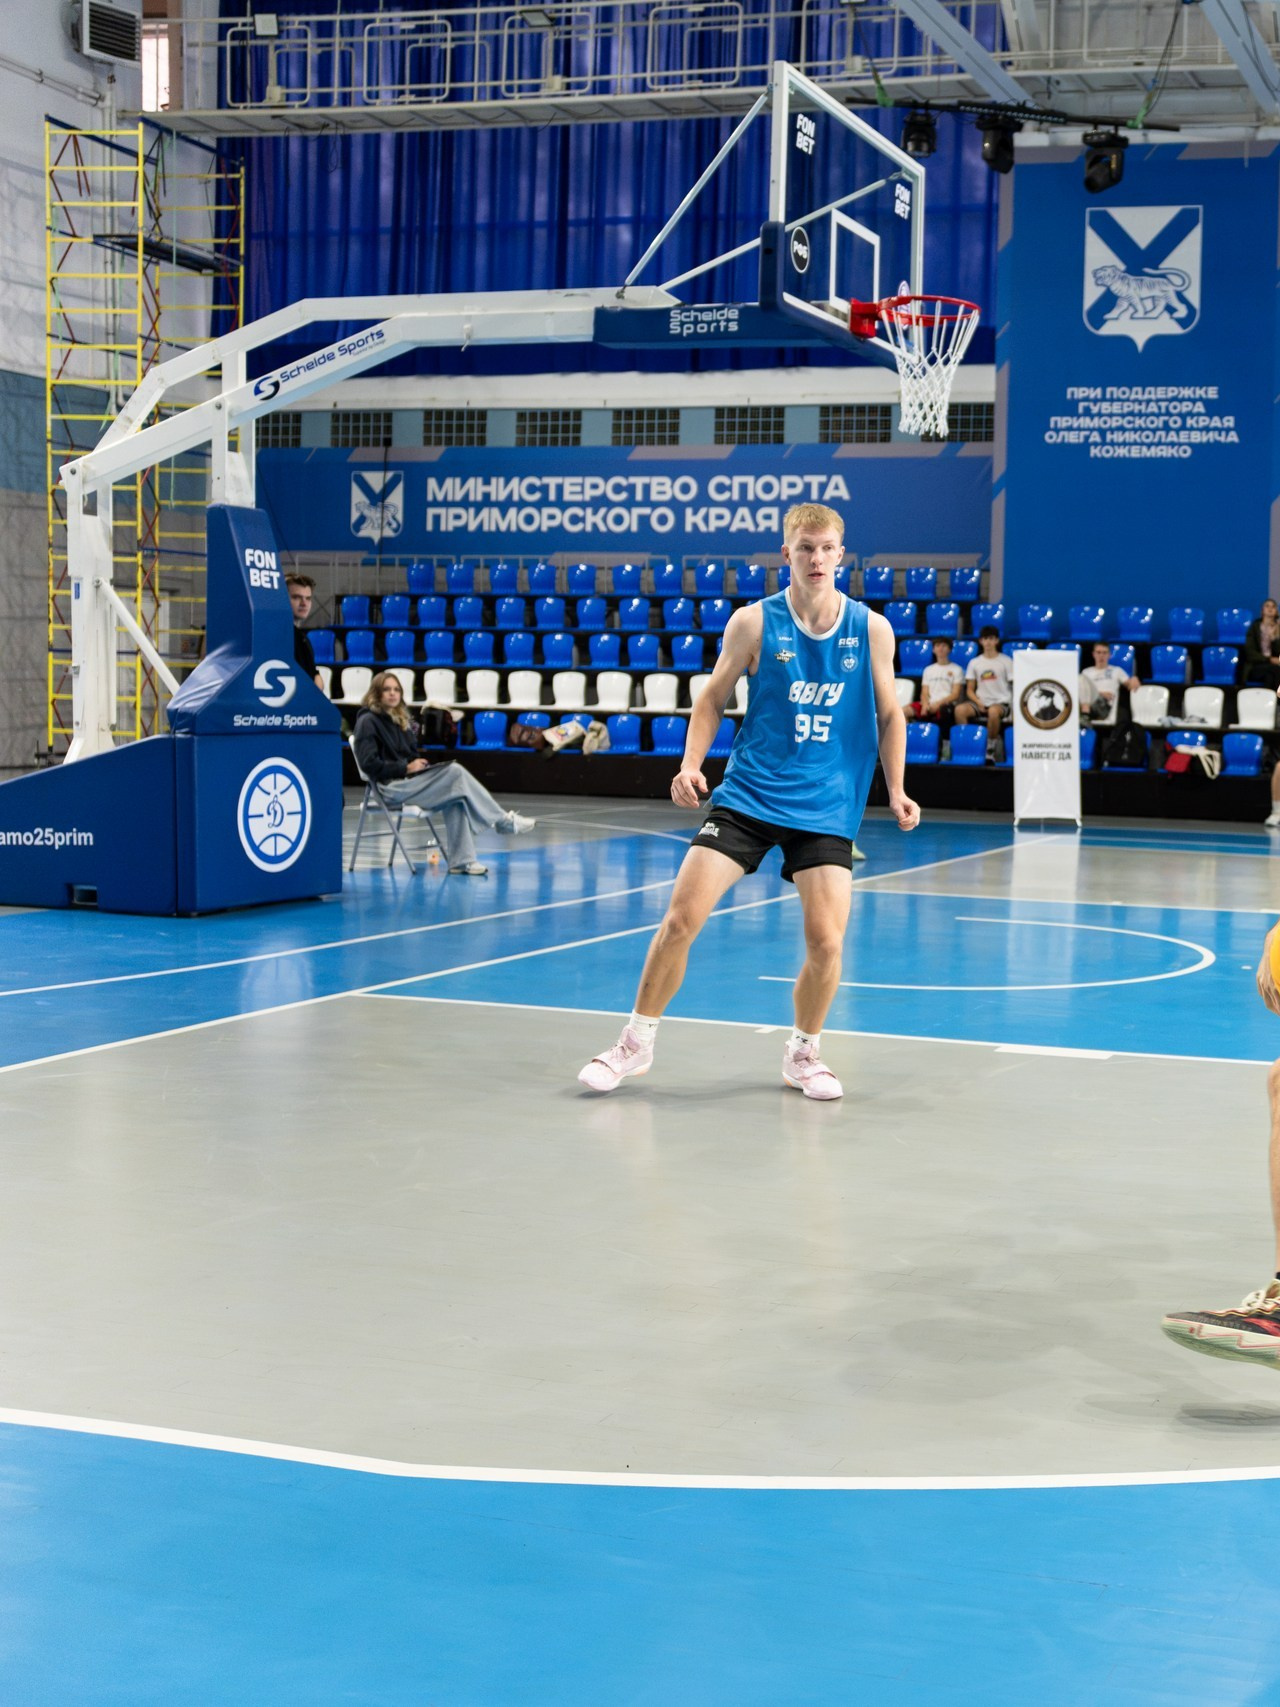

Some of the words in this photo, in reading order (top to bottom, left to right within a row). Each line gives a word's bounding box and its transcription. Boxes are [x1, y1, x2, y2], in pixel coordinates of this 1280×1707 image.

[796, 113, 815, 138] FON
[795, 134, 815, 155] BET
[895, 183, 911, 204] FON
[894, 199, 910, 220] BET
[670, 308, 739, 322] Schelde
[669, 320, 739, 337] Sports
[280, 352, 336, 383] Schelde
[338, 329, 385, 356] Sports
[1066, 386, 1102, 400] ПРИ
[1106, 386, 1219, 401] ПОДДЕРЖКЕ
[1078, 401, 1206, 414] ГУБЕРНАТОРА
[1050, 416, 1182, 429] ПРИМОРСКОГО
[1186, 416, 1235, 429] КРАЯ
[1044, 430, 1102, 443] ОЛЕГА
[1106, 430, 1239, 443] НИКОЛАЕВИЧА
[1090, 445, 1192, 458] КОЖЕМЯКО
[426, 476, 698, 502] МИНИСТЕРСТВО
[707, 475, 850, 501] СПОРТА
[426, 506, 675, 533] ПРИМОРСКОГО
[684, 506, 779, 533] КРАЯ
[245, 548, 276, 570] FON
[250, 568, 280, 589] BET
[283, 714, 318, 729] Sports
[794, 713, 833, 743] 95
